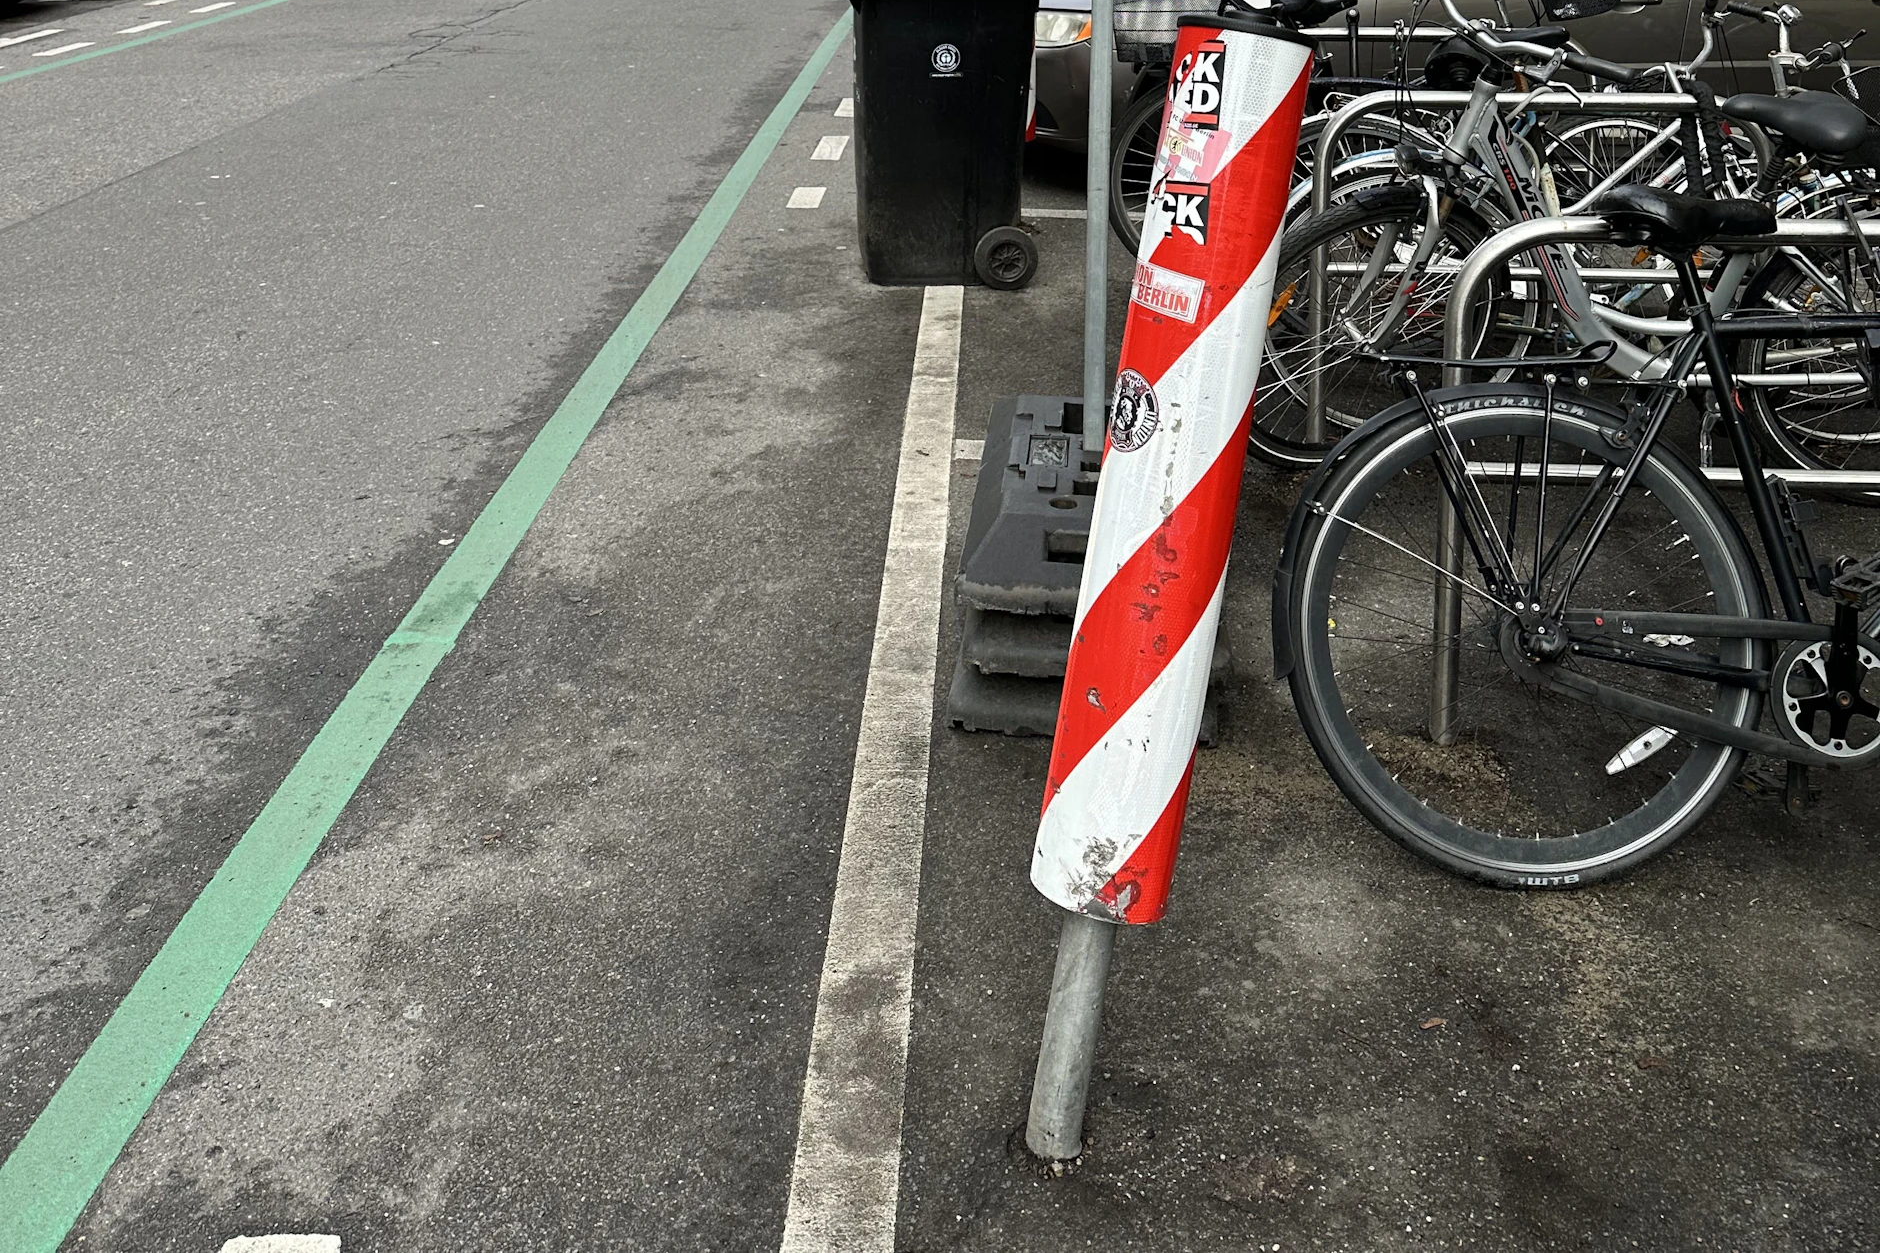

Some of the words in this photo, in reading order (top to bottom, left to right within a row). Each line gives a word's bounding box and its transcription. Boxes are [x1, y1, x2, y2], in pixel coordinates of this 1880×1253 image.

[1493, 142, 1506, 167] CRS
[1503, 167, 1517, 191] 100
[1137, 284, 1190, 313] BERLIN
[1132, 410, 1158, 448] UNION
[1527, 873, 1580, 886] WTB
